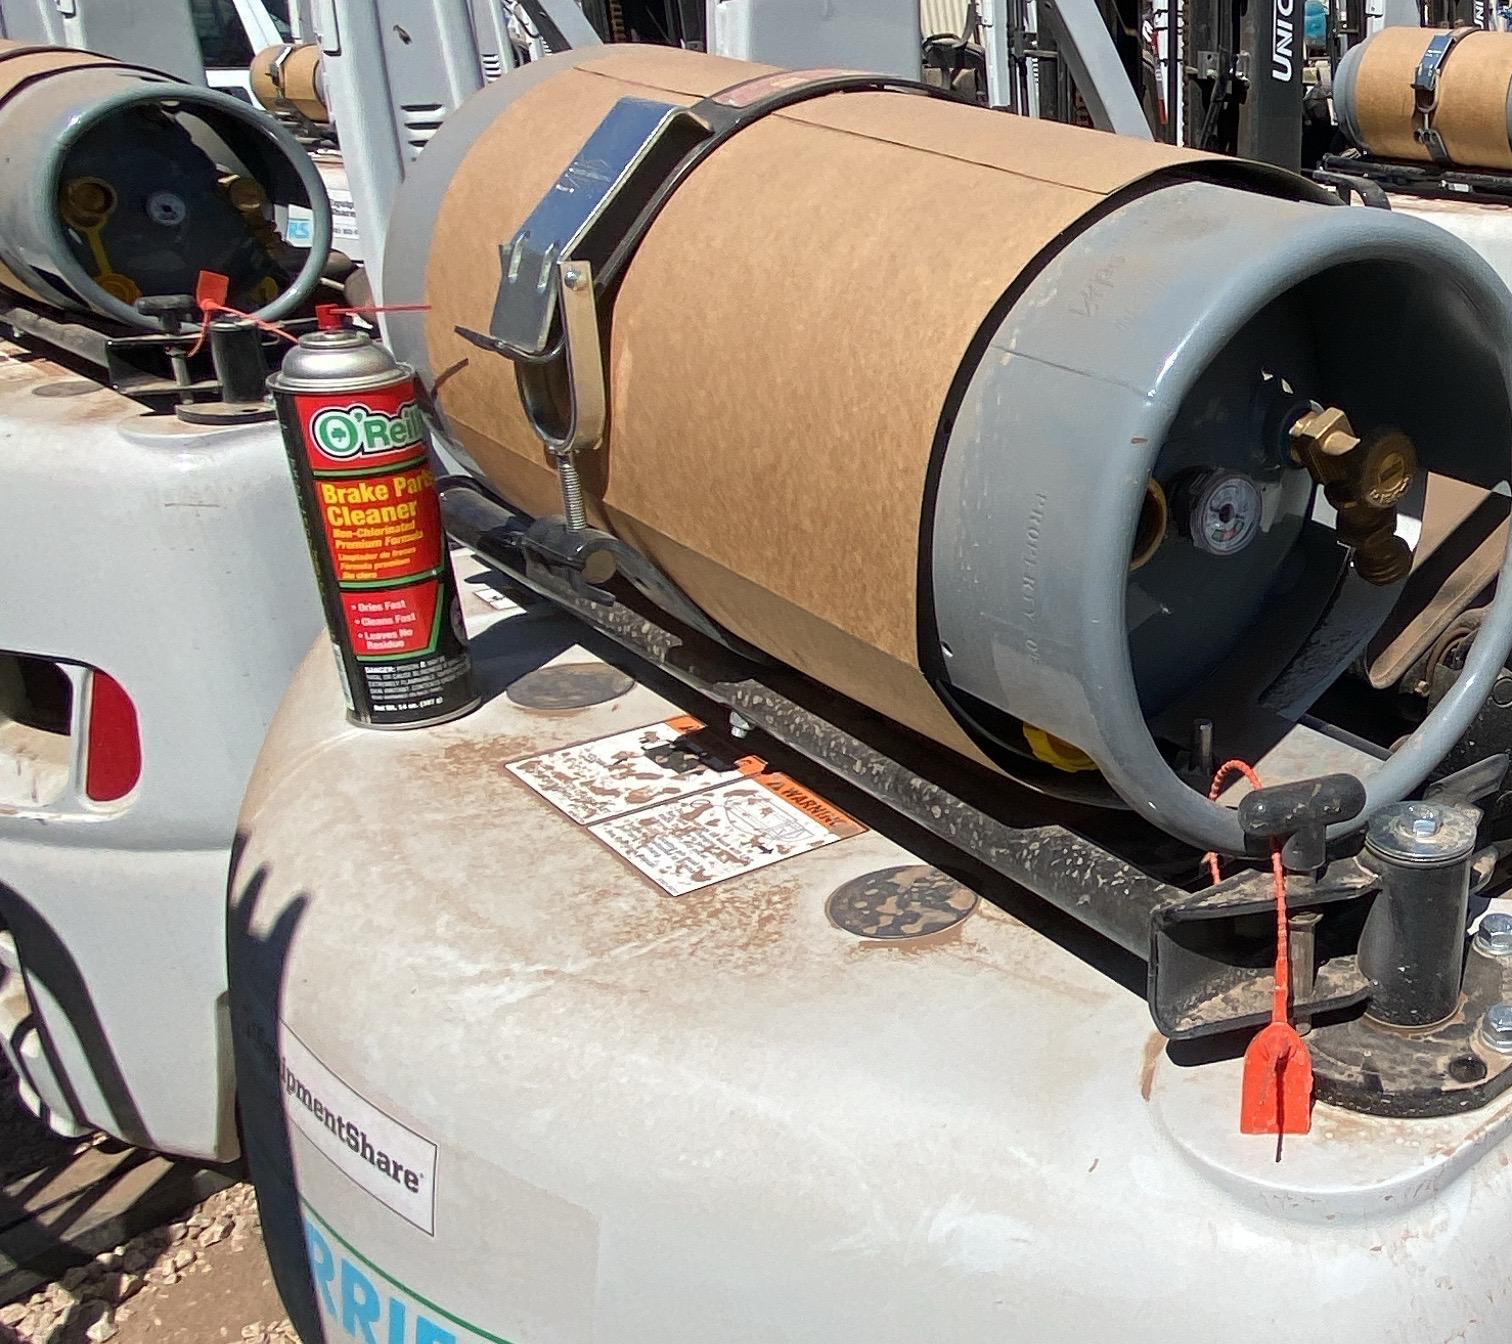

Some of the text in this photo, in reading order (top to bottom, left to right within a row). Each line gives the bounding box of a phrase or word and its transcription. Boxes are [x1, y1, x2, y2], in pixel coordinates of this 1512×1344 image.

[318, 404, 424, 454] O'Reill
[321, 481, 390, 505] Brake
[326, 500, 418, 527] Cleaner
[384, 599, 407, 611] Fast
[394, 612, 417, 624] Fast
